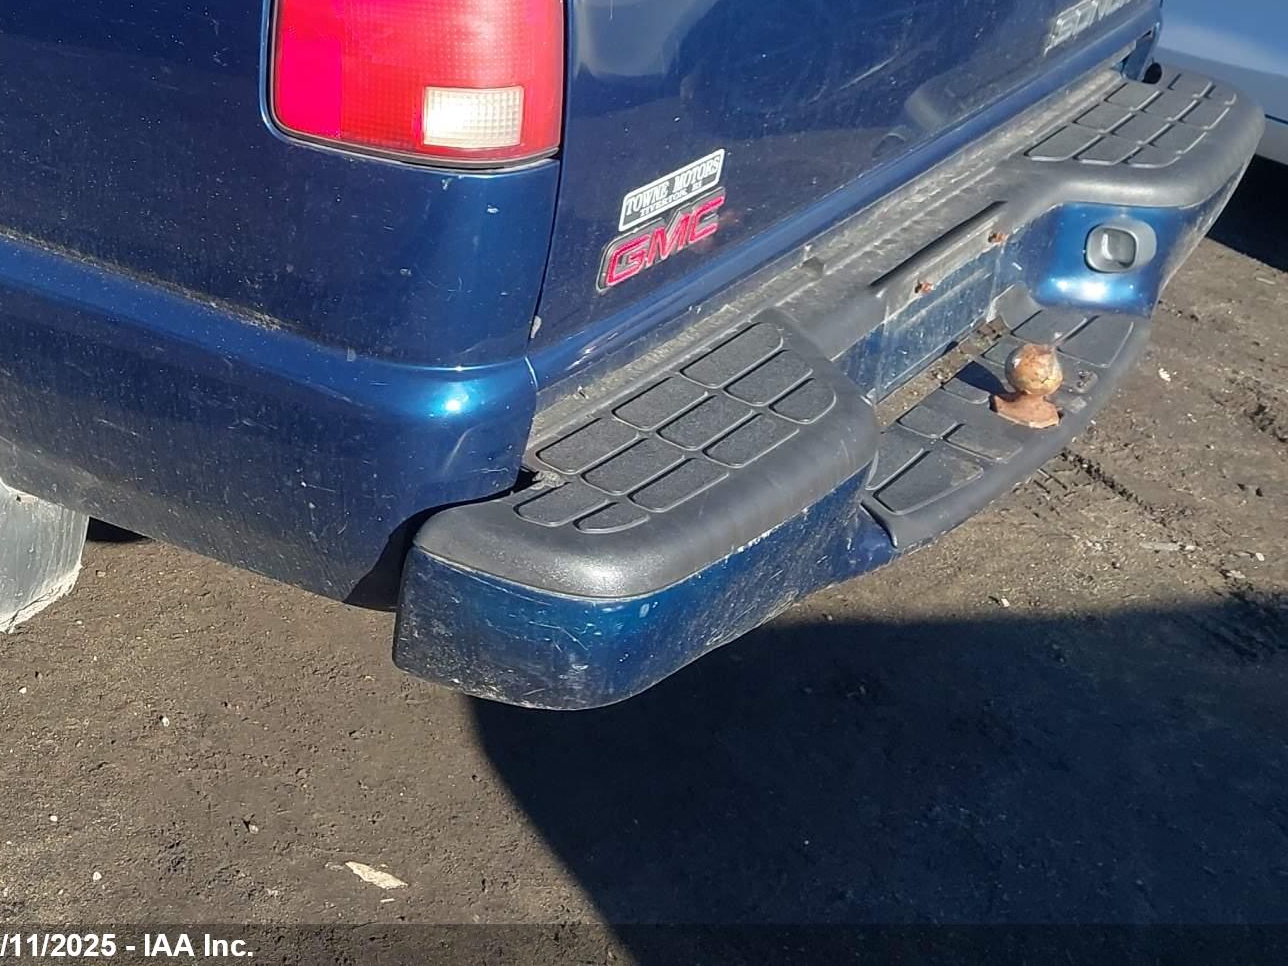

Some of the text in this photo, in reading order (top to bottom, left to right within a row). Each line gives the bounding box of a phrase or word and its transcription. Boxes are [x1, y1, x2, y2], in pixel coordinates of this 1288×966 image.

[625, 155, 721, 216] TOWNE MOTORS
[602, 192, 726, 288] GMC
